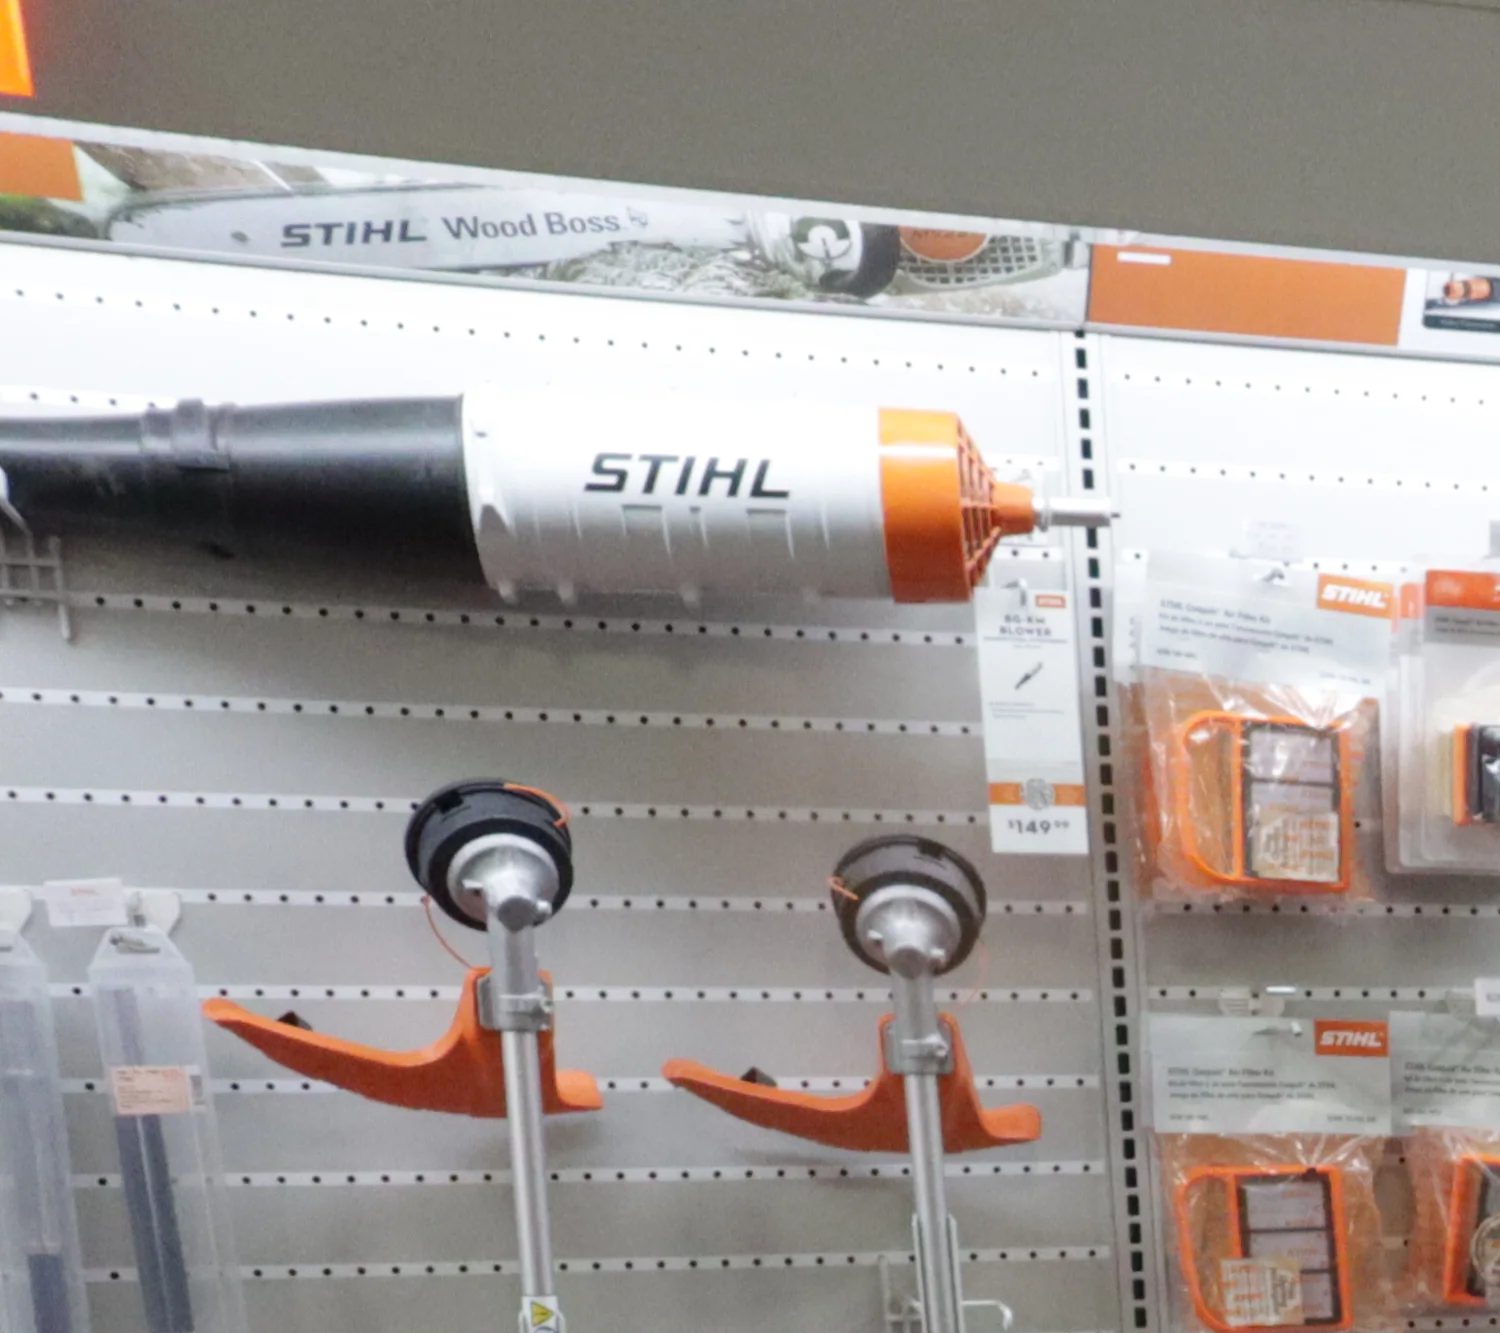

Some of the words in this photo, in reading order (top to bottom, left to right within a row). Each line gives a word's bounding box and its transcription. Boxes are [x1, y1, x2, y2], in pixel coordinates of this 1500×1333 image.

[280, 219, 427, 249] STIHL
[442, 215, 538, 241] Wood
[583, 452, 790, 499] STIHL
[1322, 583, 1387, 608] STIHL
[1000, 626, 1051, 637] BLOWER
[1320, 1030, 1382, 1047] STIHL
